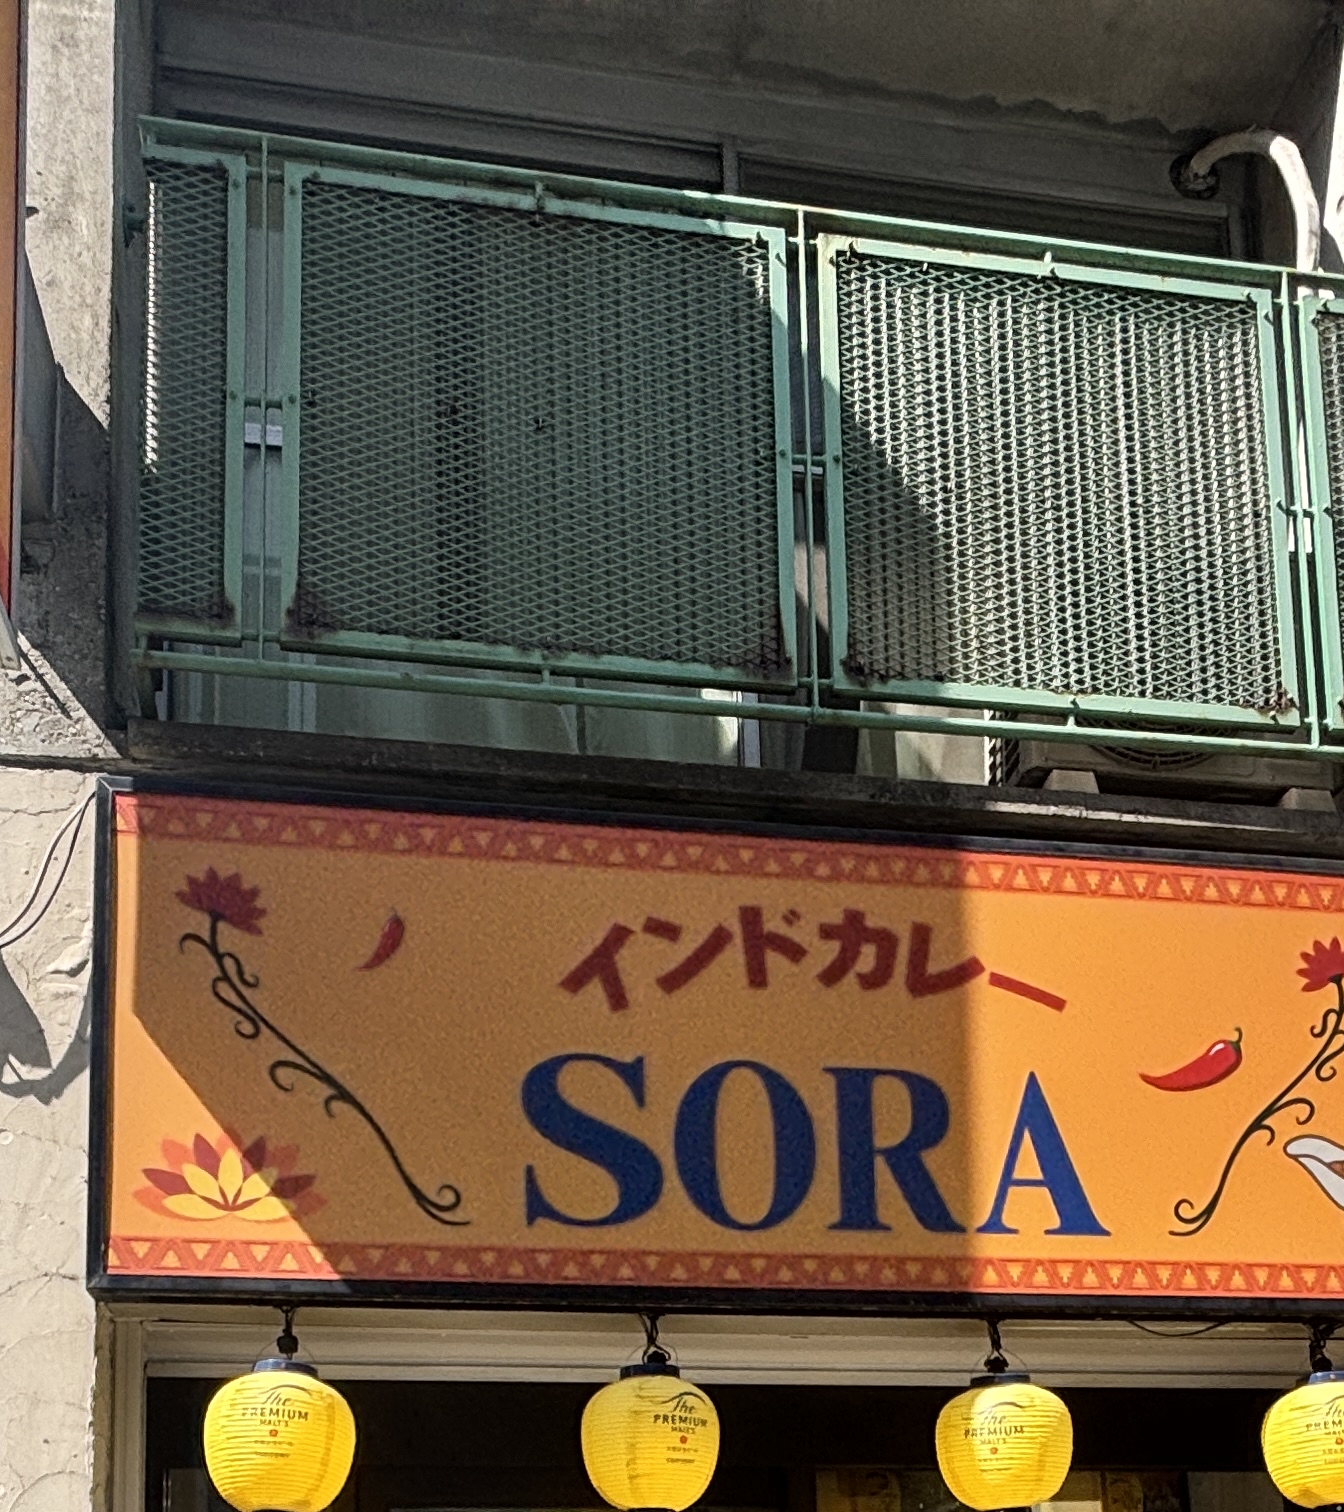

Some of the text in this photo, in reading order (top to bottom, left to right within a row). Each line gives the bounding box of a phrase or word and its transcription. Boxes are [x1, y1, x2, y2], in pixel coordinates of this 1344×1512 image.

[561, 904, 1067, 1012] インドカレー
[518, 1051, 1112, 1239] SORA
[241, 1407, 309, 1421] PREMIUM
[653, 1414, 707, 1427] PREMIUM
